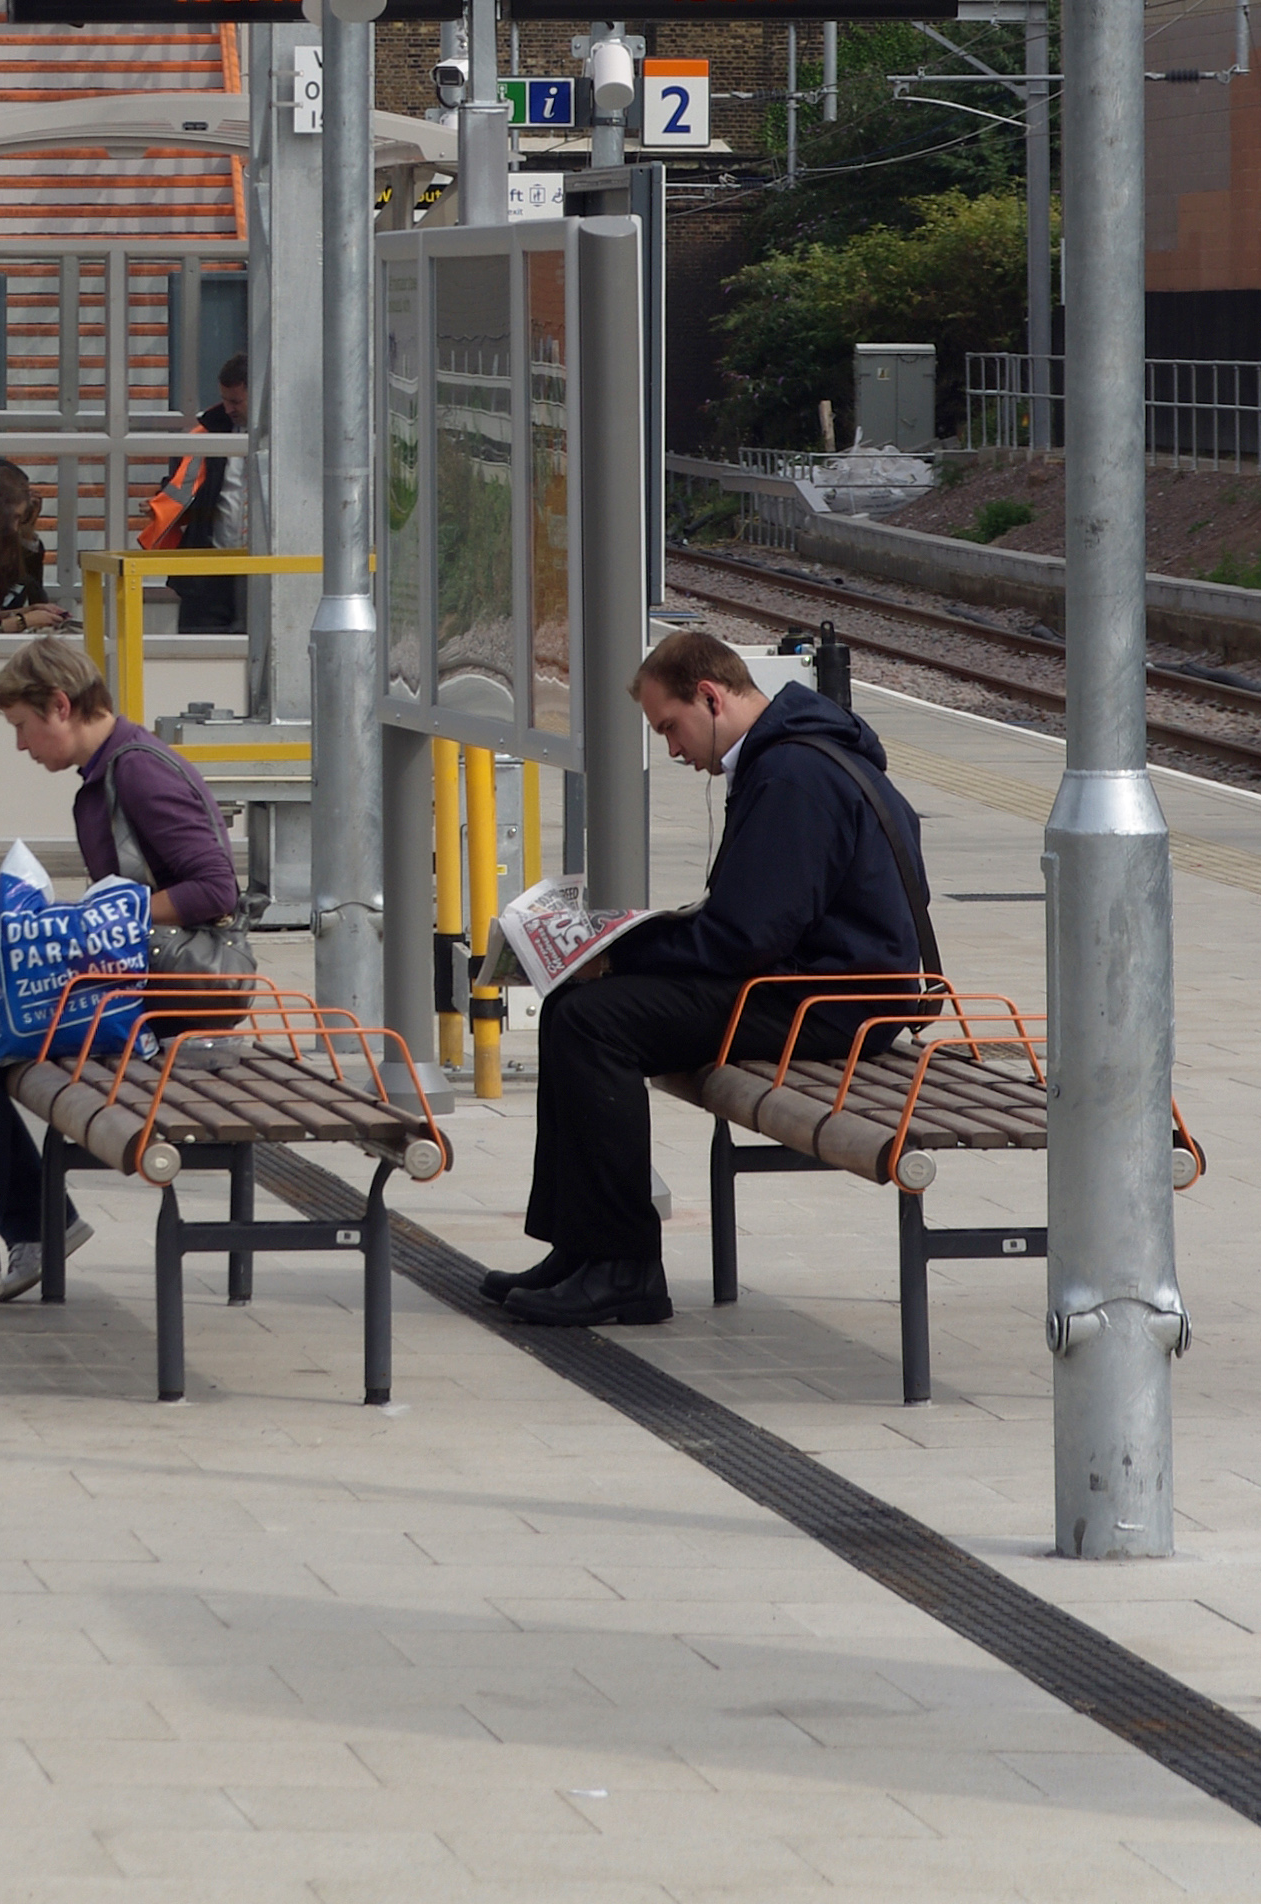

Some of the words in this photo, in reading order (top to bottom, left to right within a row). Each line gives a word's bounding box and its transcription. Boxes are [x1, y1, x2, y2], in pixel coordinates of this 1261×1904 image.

[661, 85, 692, 134] 2
[509, 188, 524, 202] ft
[7, 916, 70, 944] DUTY
[9, 921, 142, 972] PARADISE
[15, 968, 80, 997] Zurich
